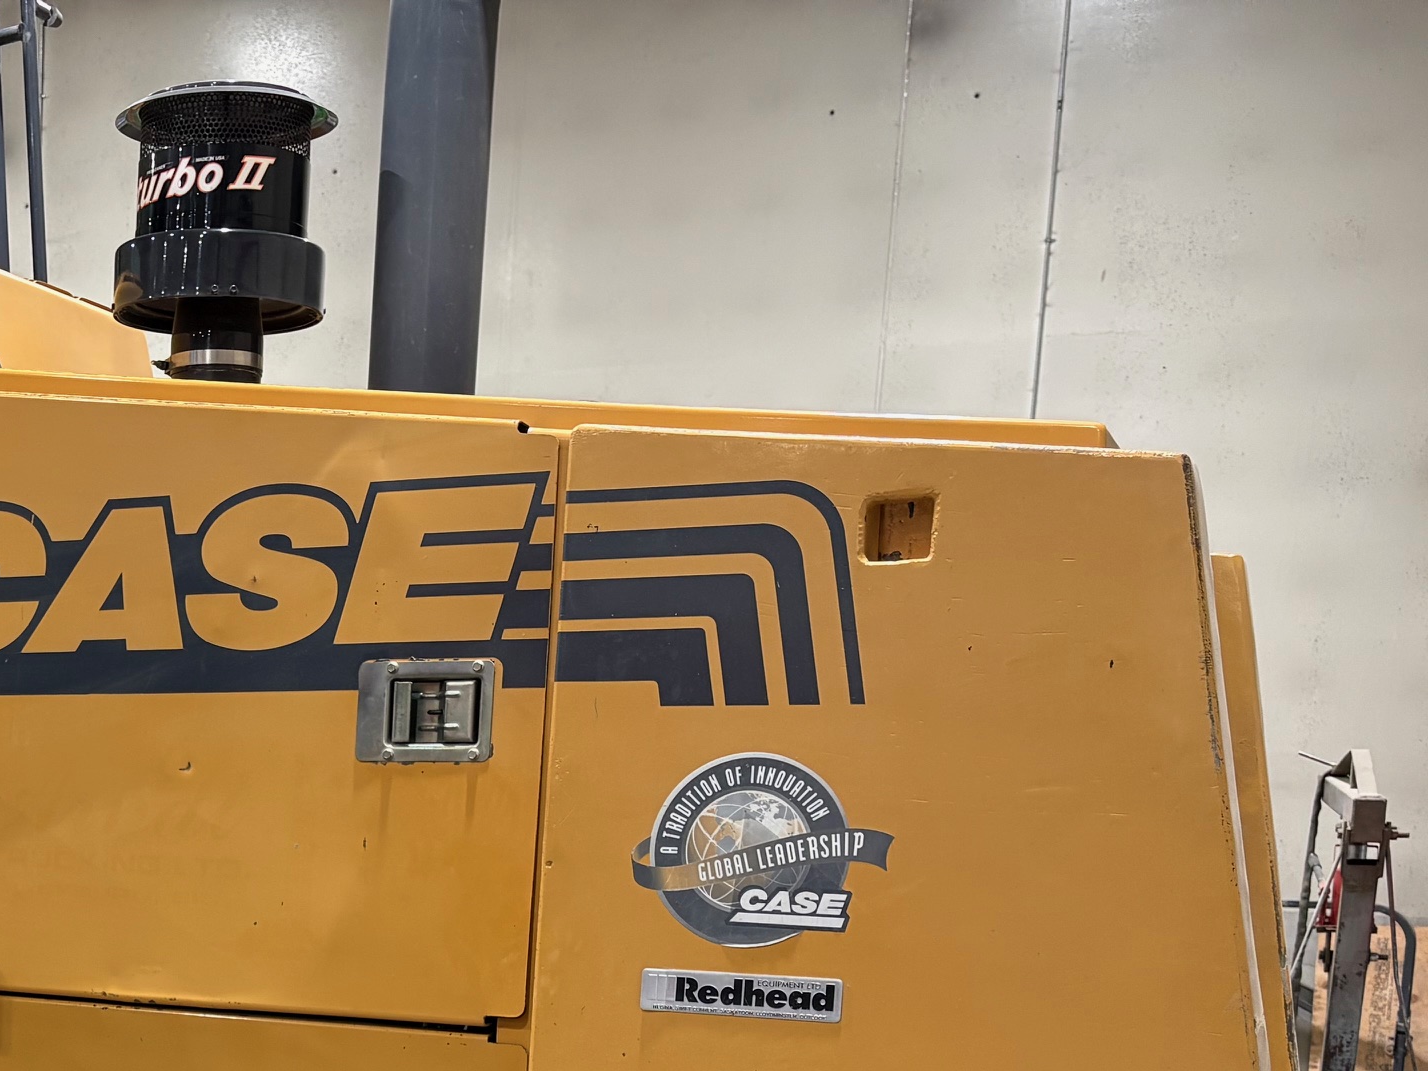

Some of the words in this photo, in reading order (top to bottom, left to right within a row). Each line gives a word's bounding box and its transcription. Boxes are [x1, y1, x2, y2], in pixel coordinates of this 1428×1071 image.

[227, 155, 276, 190] II
[725, 766, 742, 787] OF
[750, 765, 830, 822] INNOVATION
[662, 773, 722, 842] TRADITION
[660, 846, 678, 854] A
[697, 850, 753, 882] GLOBAL
[756, 831, 865, 870] LEADERSHIP
[739, 888, 848, 916] CASE
[675, 976, 836, 1012] Redhead
[757, 979, 805, 990] EQUIPMENT
